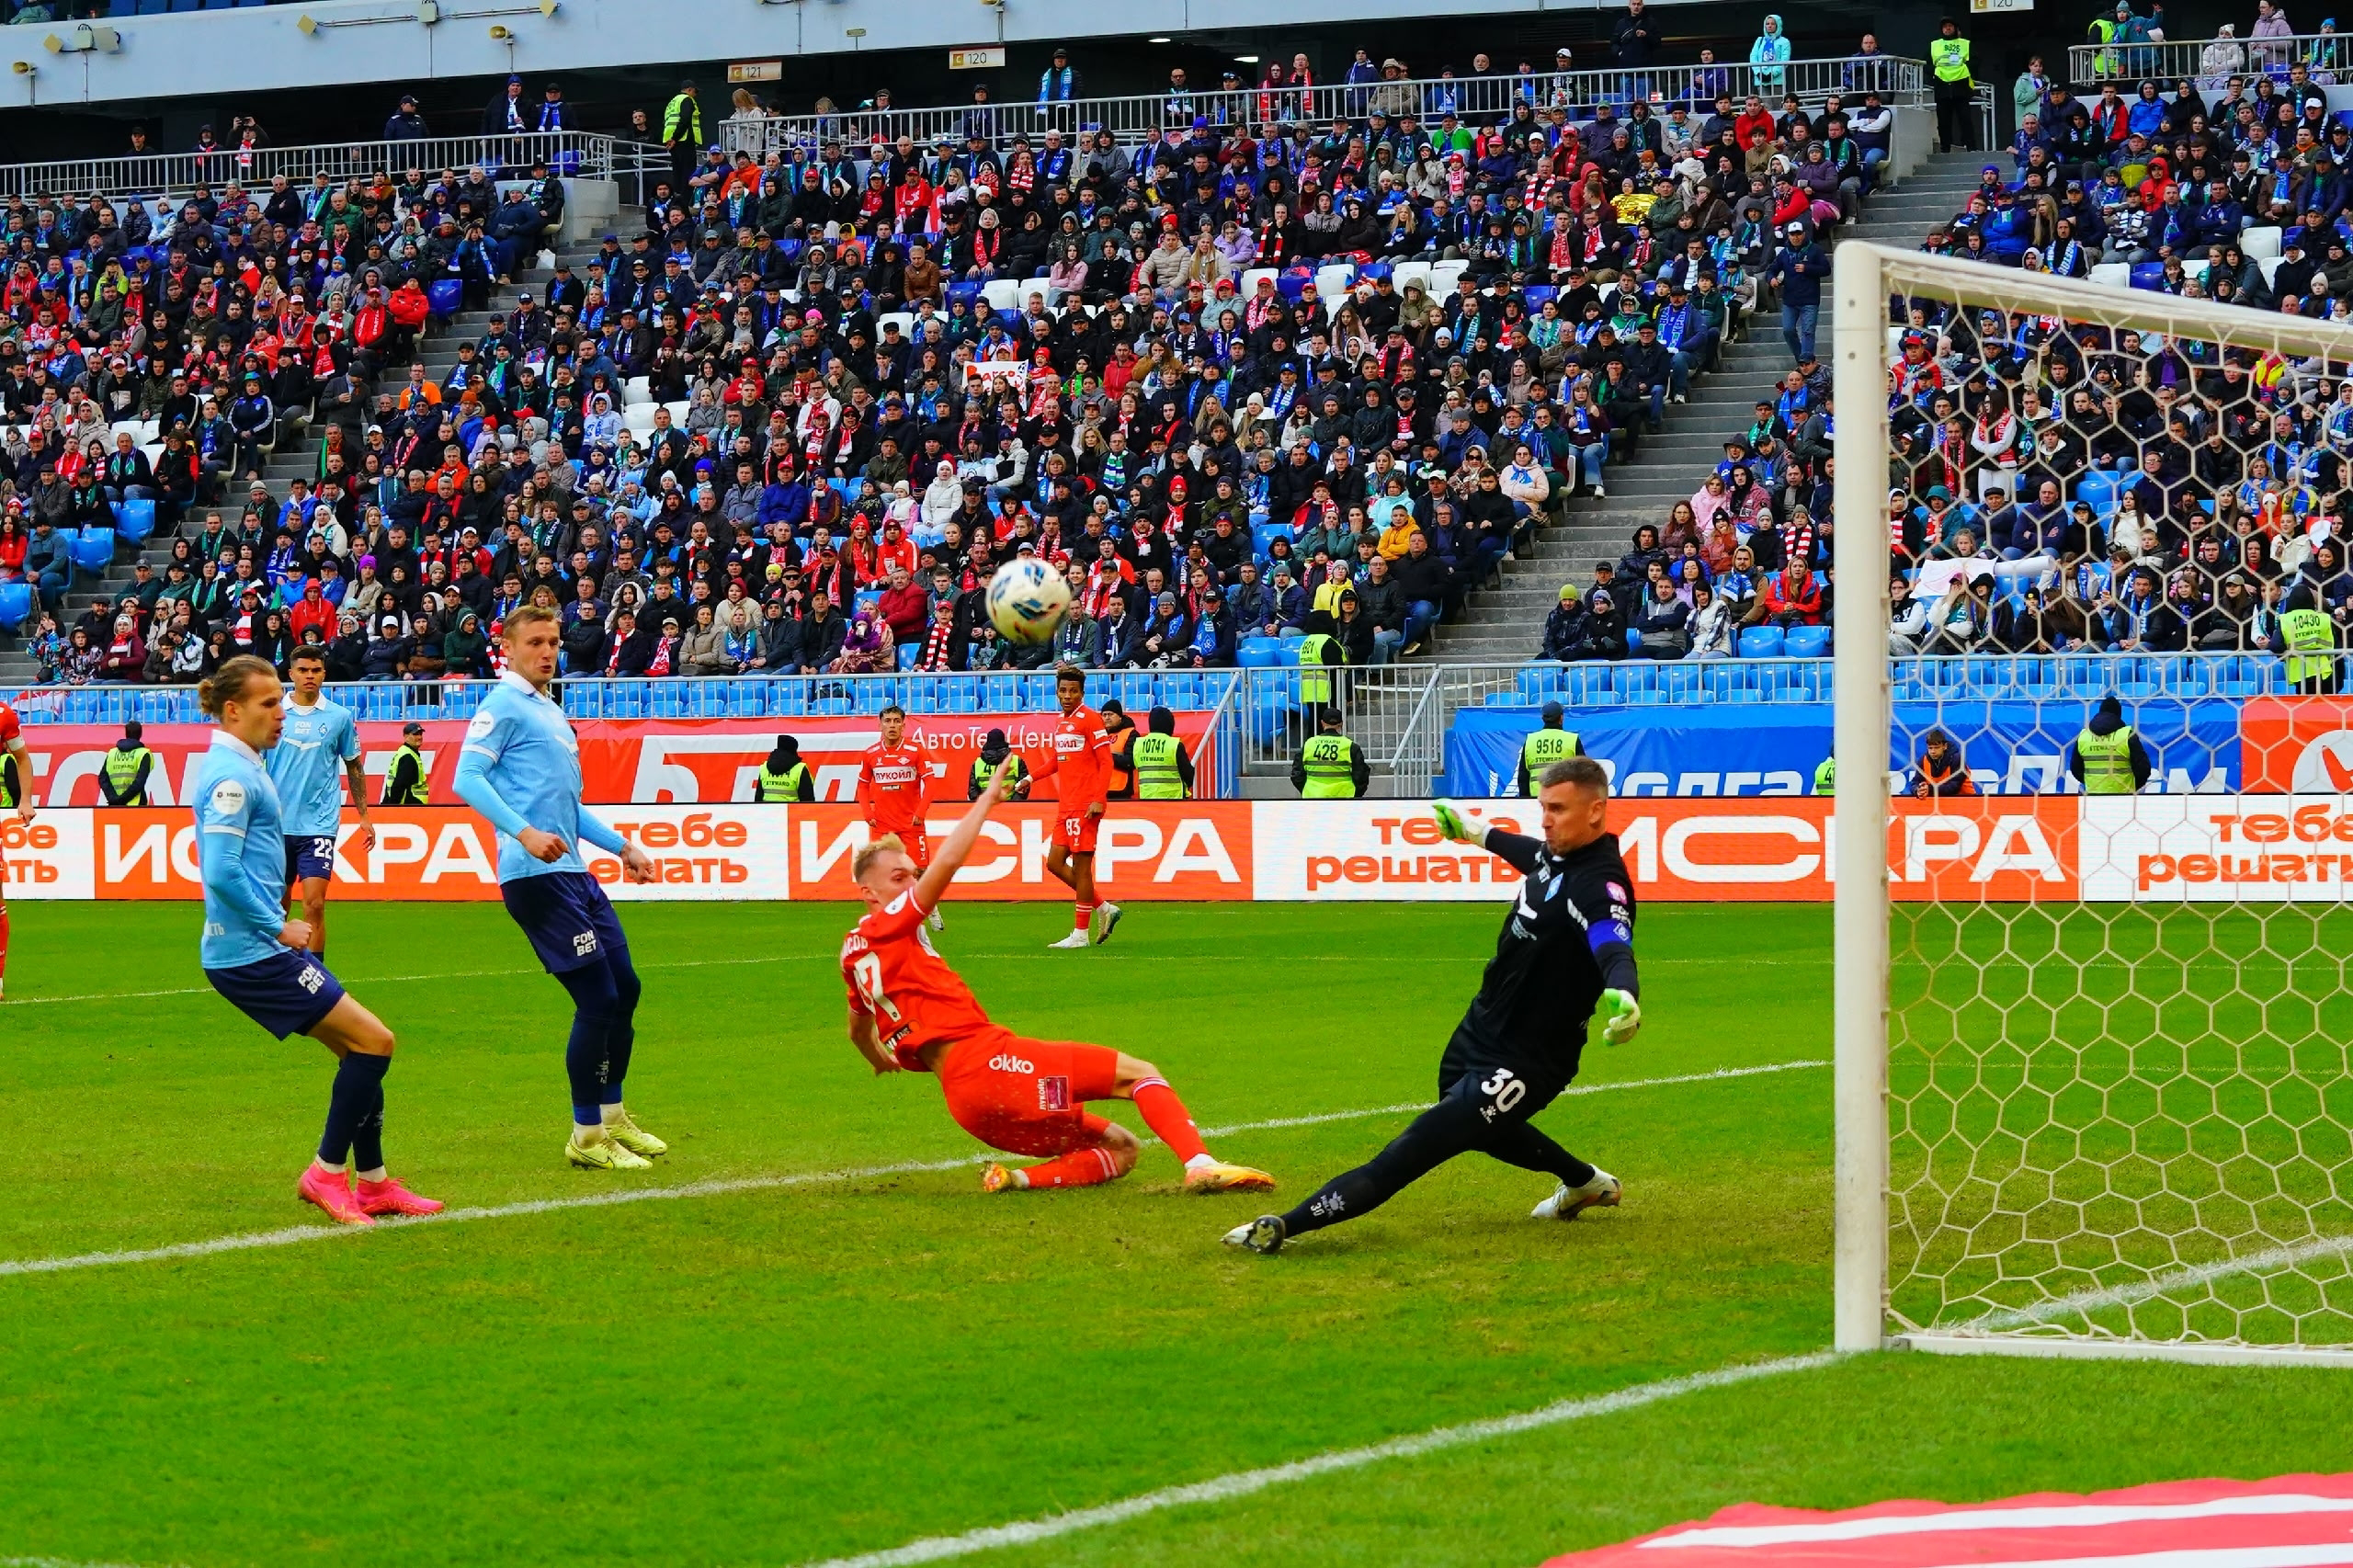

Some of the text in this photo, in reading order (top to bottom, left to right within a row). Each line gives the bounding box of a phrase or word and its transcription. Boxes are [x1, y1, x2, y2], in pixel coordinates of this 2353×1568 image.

[968, 52, 987, 64] 120
[745, 67, 762, 78] 121
[1142, 738, 1166, 754] 10741
[1313, 743, 1339, 761] 428
[1536, 738, 1563, 755] 9518
[614, 812, 747, 847] тебе
[1065, 817, 1081, 836] 83
[313, 837, 333, 860] 22
[1307, 856, 1524, 891] решать
[573, 929, 595, 947] FON
[576, 939, 597, 957] BET
[298, 962, 317, 988] FON
[306, 970, 326, 994] BET
[1481, 1067, 1527, 1113] 30
[1310, 1201, 1325, 1217] 30
